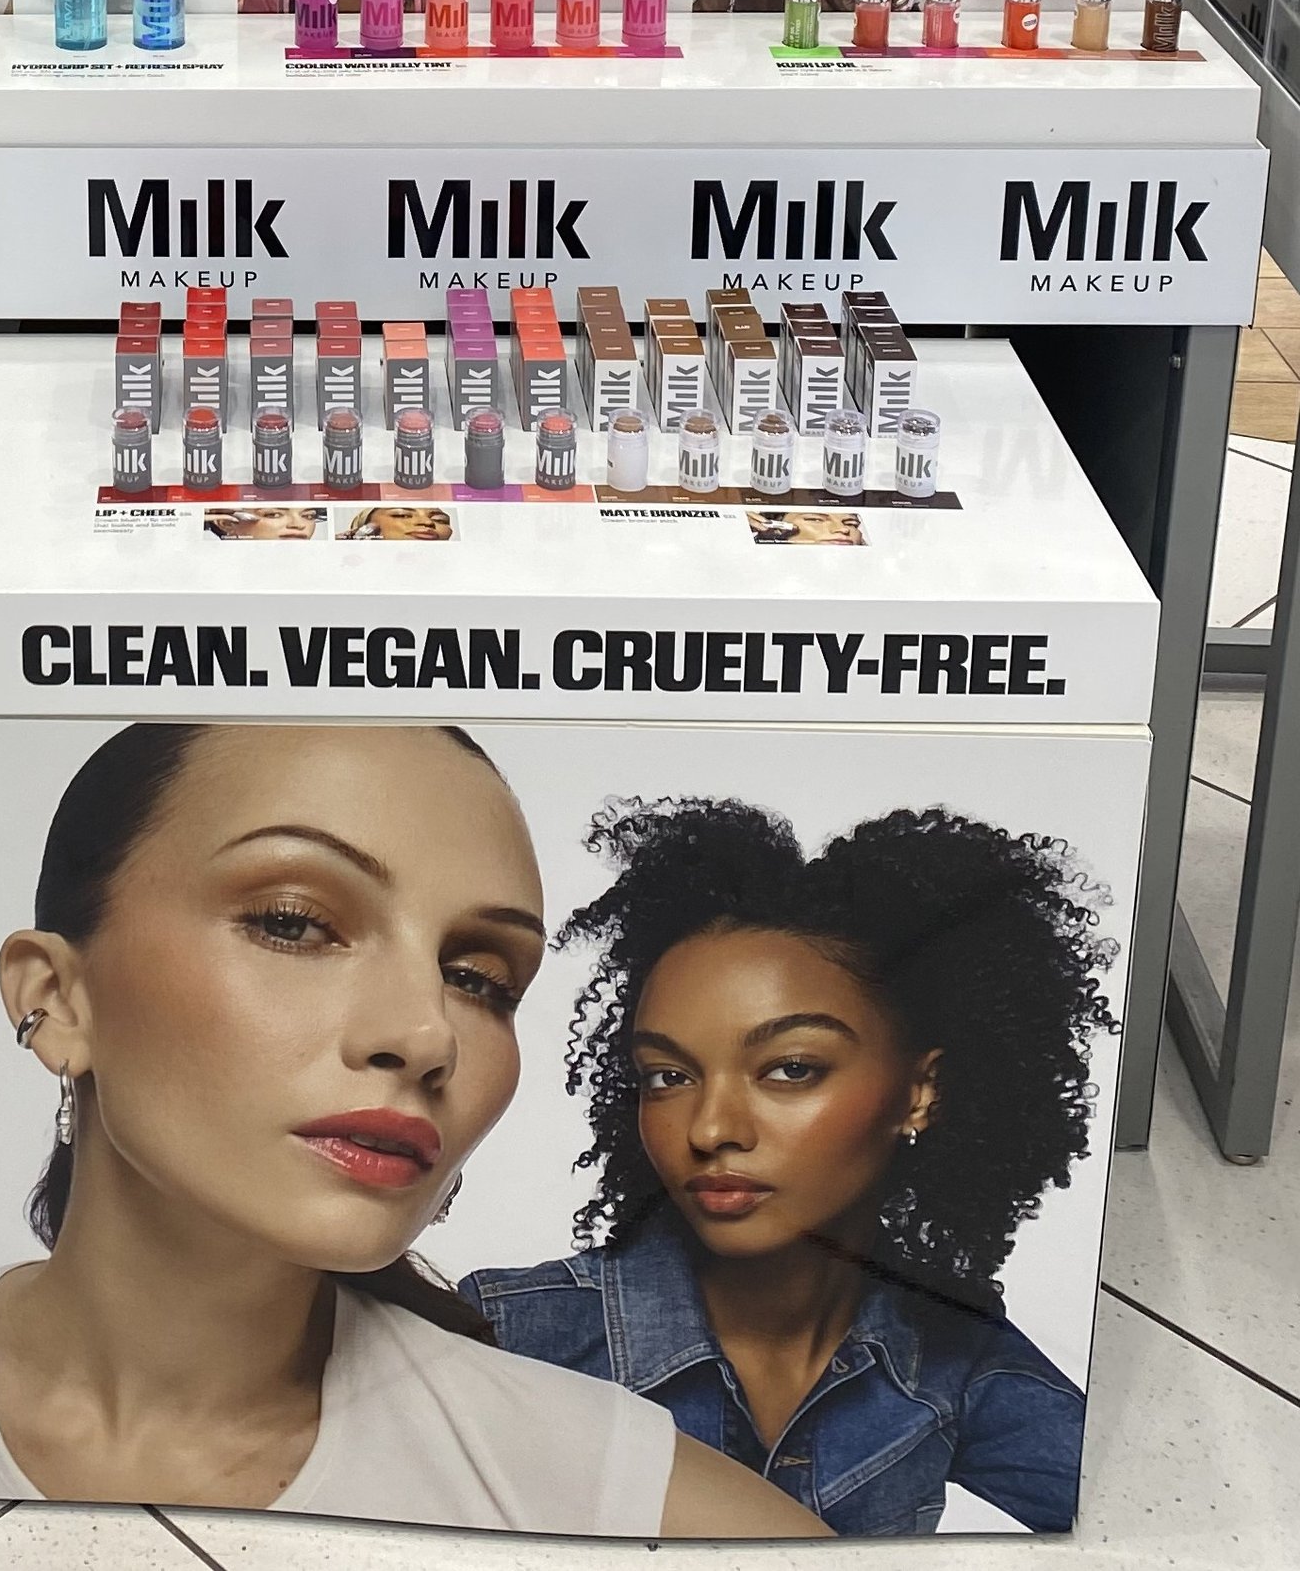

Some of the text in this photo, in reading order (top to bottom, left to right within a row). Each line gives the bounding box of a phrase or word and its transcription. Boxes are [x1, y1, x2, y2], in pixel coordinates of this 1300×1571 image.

[365, 0, 402, 27] Mil
[495, 1, 533, 28] Mil
[11, 63, 58, 71] HYDRO
[776, 61, 814, 69] KUSH
[87, 178, 289, 259] Milk
[387, 179, 591, 259] Milk
[690, 180, 898, 260] Milk
[1000, 180, 1210, 261] Milk
[120, 270, 259, 289] MAKEUP
[419, 271, 558, 289] MAKEUP
[723, 272, 865, 292] MAKEUP
[1030, 274, 1176, 293] MAKEUP
[806, 367, 839, 429] Milk
[878, 371, 911, 432] Milk
[113, 449, 147, 473] ilk
[184, 449, 216, 473] ilk
[253, 449, 287, 473] ilk
[95, 509, 117, 517] LIP
[129, 509, 177, 517] CHEEK
[600, 509, 649, 518] MATTE
[650, 510, 720, 518] BRONZER
[20, 625, 1066, 697] CLEAN. VEGAN. CRUELTY-FREE.
